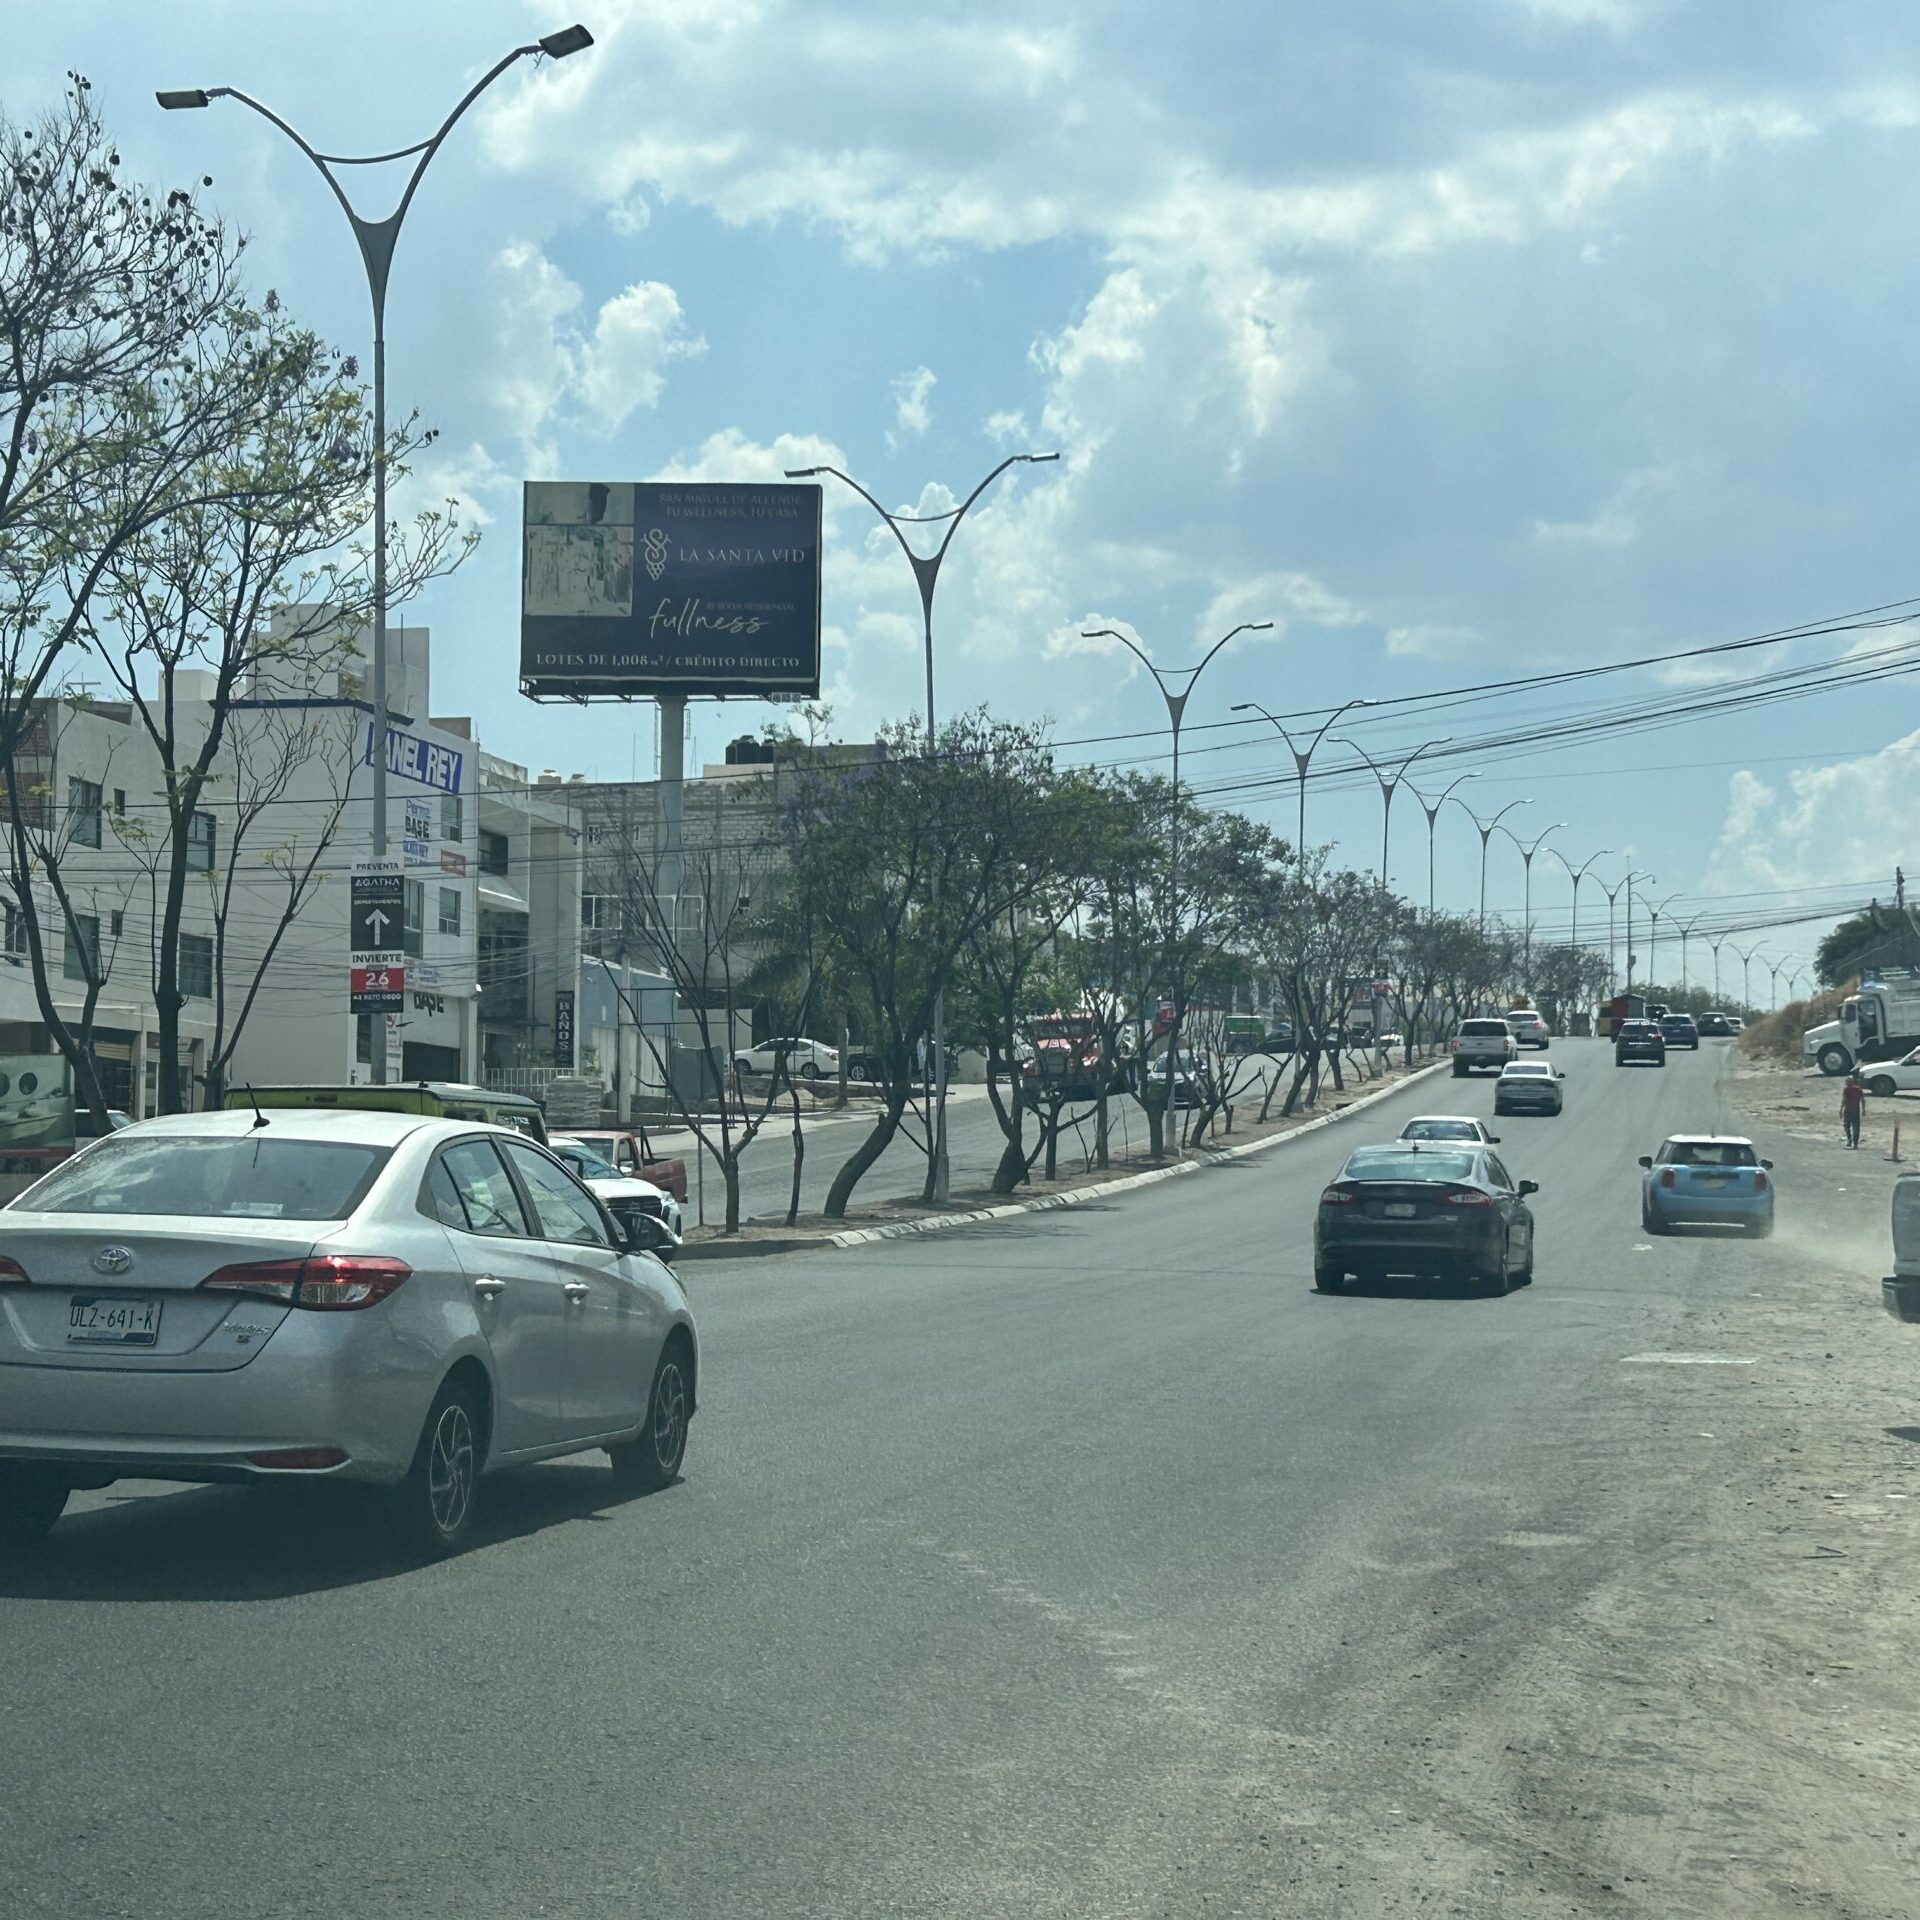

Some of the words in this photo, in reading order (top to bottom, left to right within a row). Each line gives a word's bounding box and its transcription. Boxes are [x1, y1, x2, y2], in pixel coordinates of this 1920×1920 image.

[680, 548, 700, 562] LA
[706, 548, 764, 562] SANTA
[771, 549, 805, 563] VID
[648, 597, 770, 639] fullness
[536, 653, 585, 665] LOTES
[588, 654, 608, 666] DE
[675, 654, 736, 668] CRÉDITO
[740, 656, 800, 668] DIRECTO
[425, 744, 459, 791] REY
[356, 862, 400, 871] PREVENTA
[352, 953, 403, 964] INVIERTE
[69, 1306, 156, 1331] ULZ-641-K
